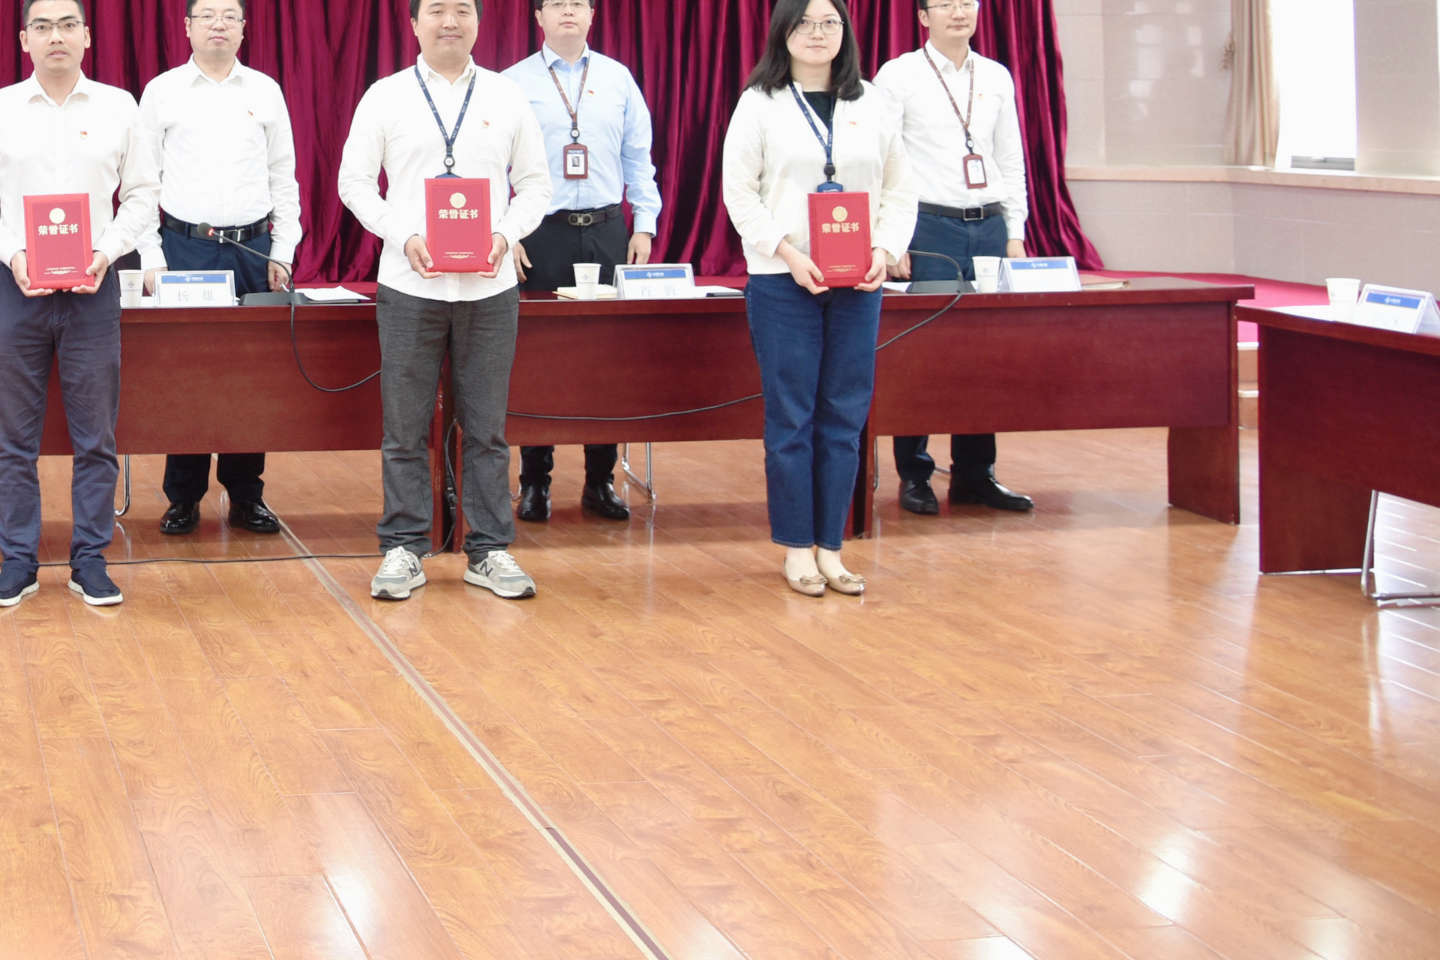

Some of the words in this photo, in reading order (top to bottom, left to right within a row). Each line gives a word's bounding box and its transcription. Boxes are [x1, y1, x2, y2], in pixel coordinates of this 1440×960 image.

[438, 208, 479, 220] 荣誉证书
[37, 223, 79, 236] 荣誉证书
[821, 222, 860, 234] 荣誉证书
